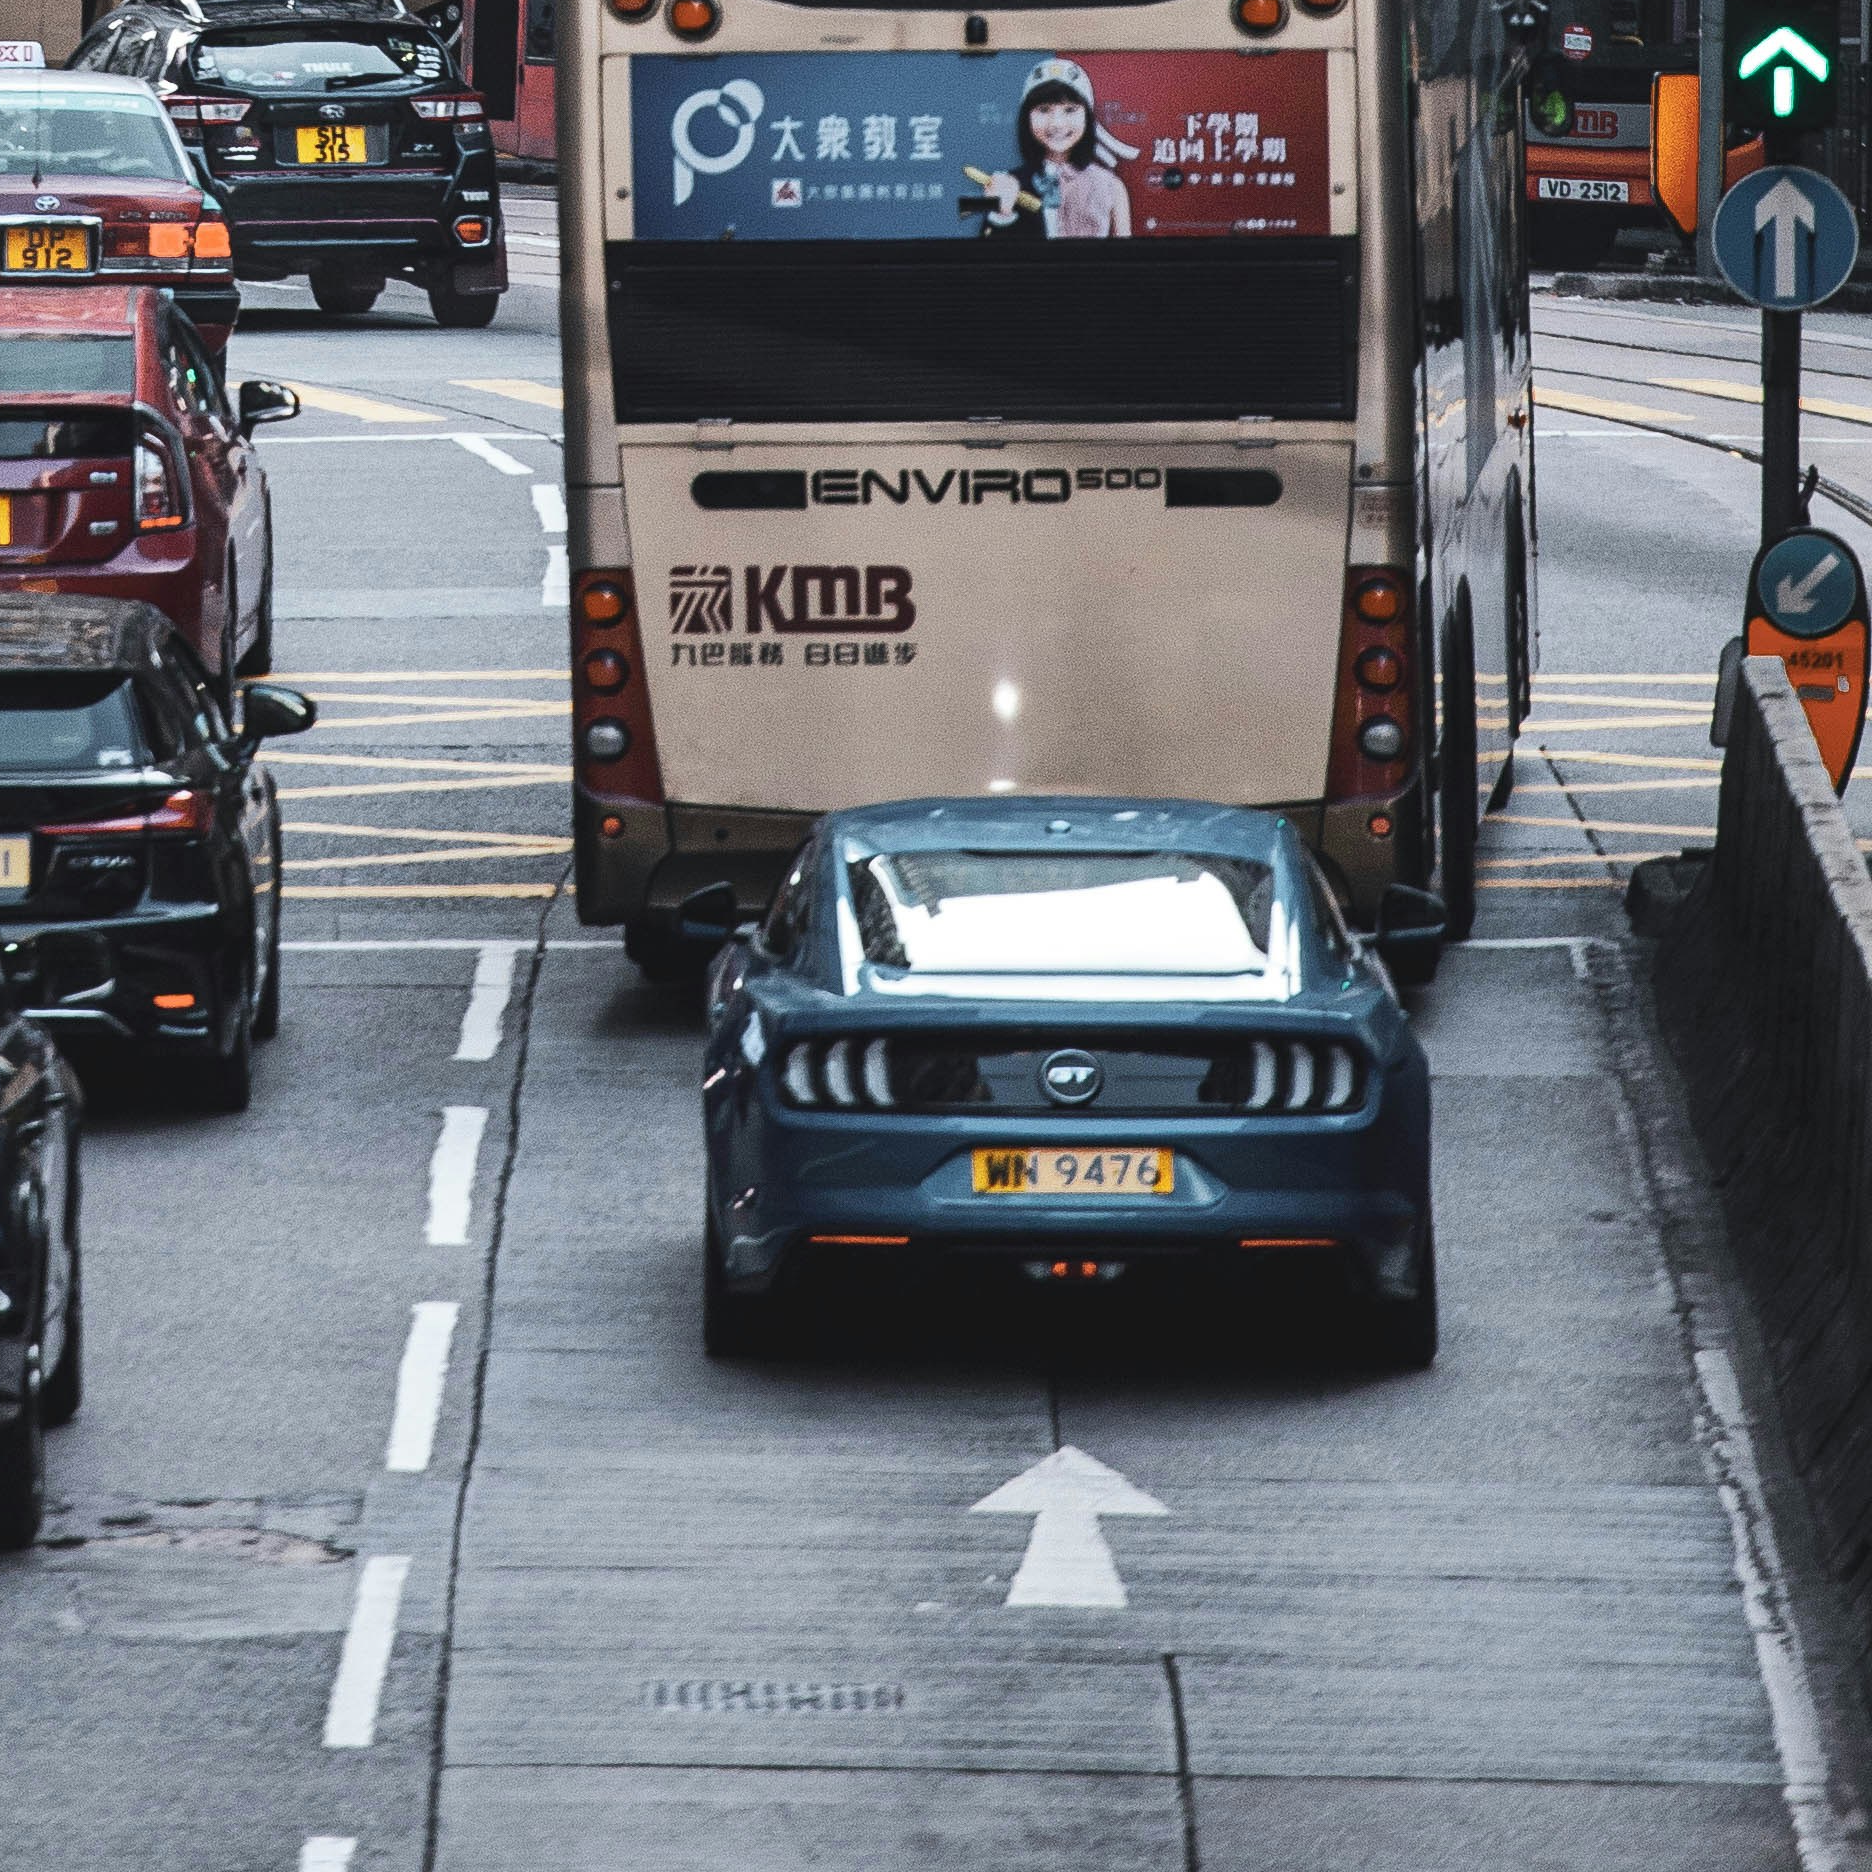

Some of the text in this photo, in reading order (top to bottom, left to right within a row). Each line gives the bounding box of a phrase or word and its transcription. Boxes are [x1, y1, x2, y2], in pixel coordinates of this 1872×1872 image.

[300, 61, 355, 74] THULE
[316, 125, 347, 145] SH
[314, 143, 351, 164] 315
[1547, 179, 1622, 202] VD 2512
[21, 248, 72, 270] 912
[744, 564, 917, 635] KMB
[670, 640, 919, 668] 九巴服務 日日進步
[985, 1153, 1162, 1188] WN 9476
